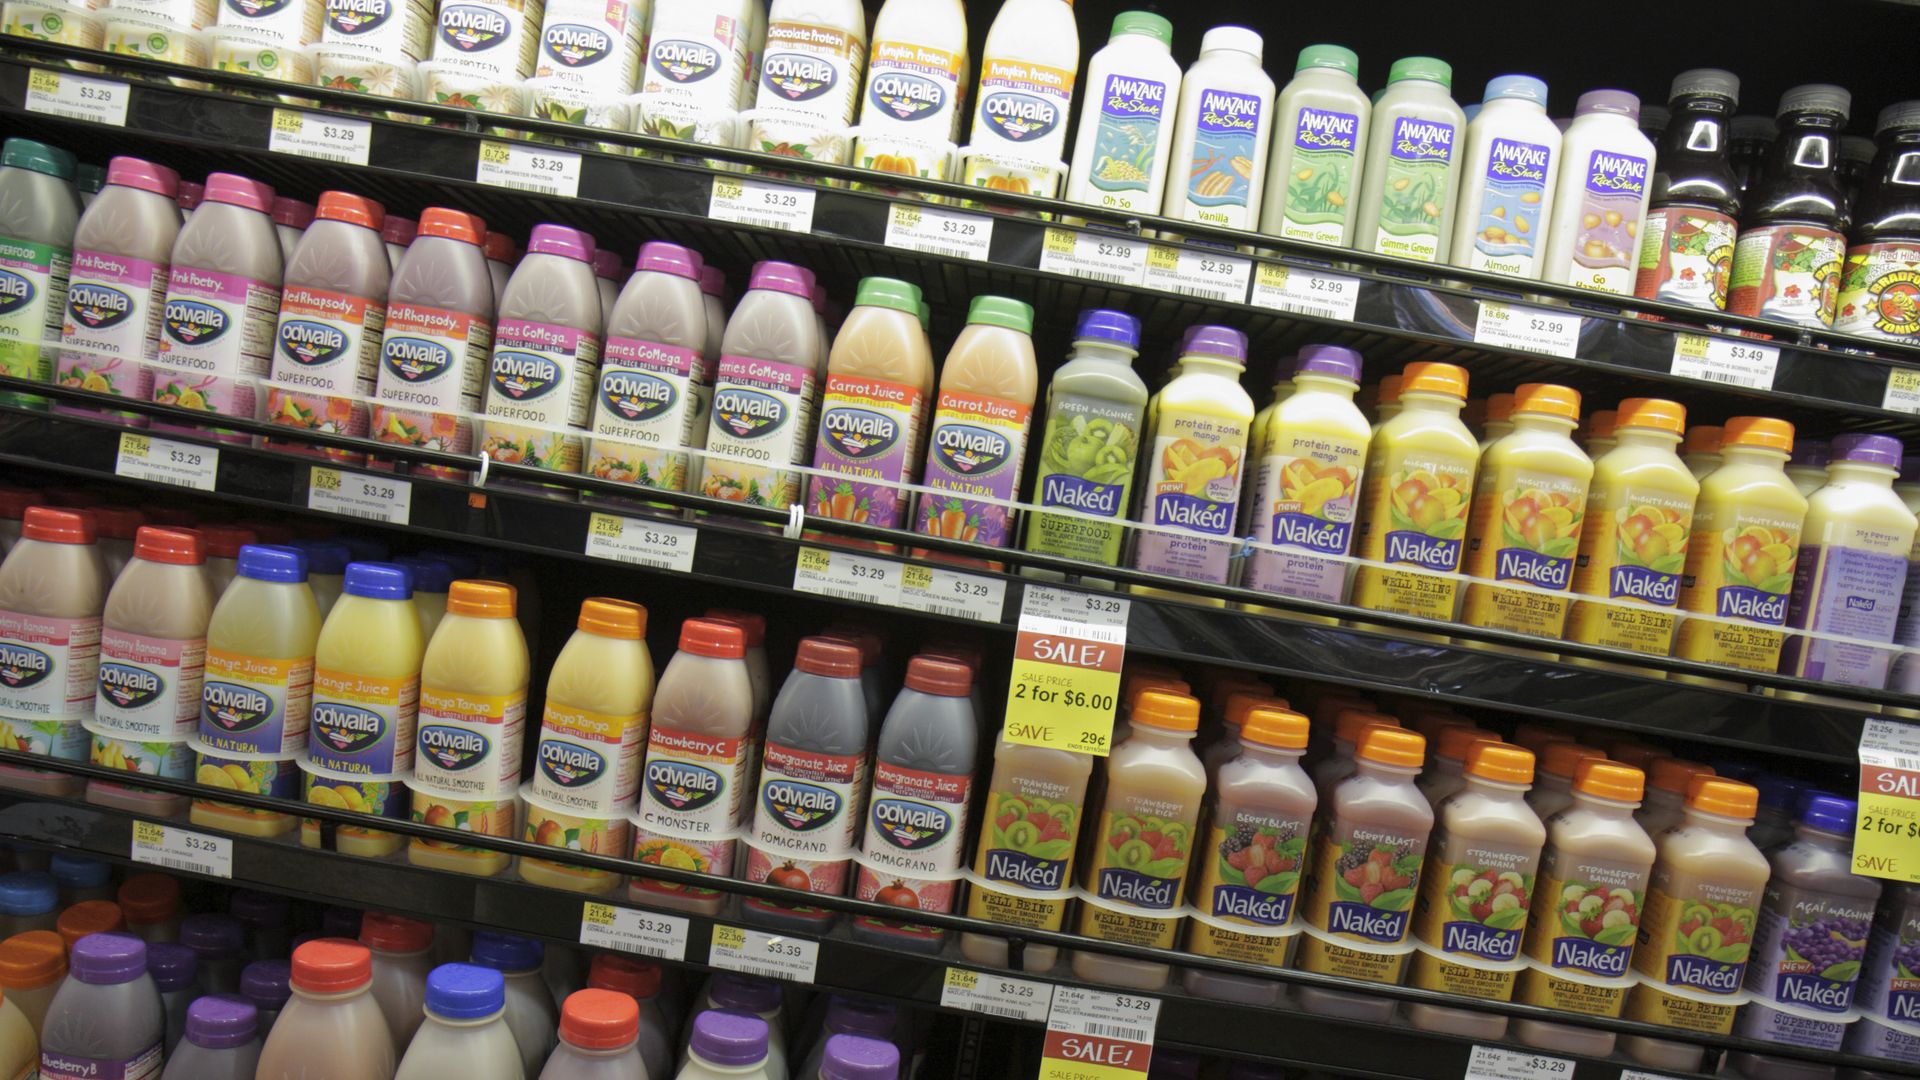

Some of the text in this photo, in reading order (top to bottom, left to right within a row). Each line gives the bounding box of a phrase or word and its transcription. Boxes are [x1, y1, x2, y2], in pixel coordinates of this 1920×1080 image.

[811, 29, 844, 47] Protein
[879, 43, 948, 66] Pumpkin Protein
[990, 62, 1062, 85] Pumpkin Protein
[80, 86, 112, 101] $3.29
[1109, 76, 1163, 101] AMAZAKE
[1108, 96, 1160, 116] Rice Shake
[1203, 91, 1257, 116] AMAZAKE
[1202, 111, 1255, 130] Rice Shake
[1301, 110, 1354, 135] AMAZAKE
[323, 126, 354, 141] $3.29
[1299, 130, 1351, 149] Rice Shake
[1398, 120, 1451, 145] AMAZAKE
[1493, 141, 1546, 167] AMAZAKE
[531, 157, 563, 173] $3.29
[1492, 162, 1543, 181] Rice Shake
[1593, 153, 1645, 179] AMAZAKE
[764, 192, 797, 208] $3.29
[1103, 195, 1131, 208] Oh So
[1198, 210, 1229, 223] Vanilla
[943, 220, 976, 236] $3.29
[1285, 226, 1339, 243] Gimme Green
[1098, 243, 1131, 258] $2.99
[76, 253, 126, 275] Pink Poetry
[1200, 260, 1233, 275] $2.99
[1483, 259, 1520, 274] Almond
[172, 271, 222, 292] Pink Poetry
[1310, 278, 1343, 294] $2.99
[1592, 274, 1606, 284] Go
[300, 291, 352, 313] Rhapsody
[403, 308, 455, 330] Rhapsody
[1530, 319, 1563, 334] $2.99
[1875, 318, 1920, 335] TONIC
[1731, 346, 1763, 361] $3.49
[161, 355, 215, 371] SUPERFOOD
[829, 378, 905, 401] Carrot Juice
[941, 395, 1018, 419] Carrot Juice
[1058, 401, 1089, 413] GREEN
[599, 424, 660, 443] SUPERFOOD
[1174, 418, 1213, 434] protein
[1192, 430, 1221, 442] mango
[1292, 437, 1331, 452] protein
[170, 450, 201, 466] $3.29
[1311, 449, 1339, 463] mango
[363, 484, 395, 500] $3.29
[931, 479, 995, 498] ALL NATURAL
[1046, 480, 1114, 512] Naked
[1159, 483, 1185, 494] new!
[1159, 498, 1227, 530] Naked
[644, 531, 677, 547] $3.29
[1169, 538, 1208, 553] protein
[1389, 536, 1456, 566] Naked
[851, 564, 885, 580] $3.29
[1500, 553, 1566, 585] Naked
[954, 581, 988, 597] $3.29
[1086, 598, 1120, 613] $3.29
[1492, 592, 1561, 613] WELL BEING
[1722, 591, 1785, 621] Naked
[135, 640, 167, 656] Banana
[1033, 639, 1105, 667] SALE!
[355, 678, 390, 695] Juice
[1022, 673, 1072, 688] SALE PRICE
[423, 692, 491, 713] Mango Tango
[1015, 684, 1113, 711] 2 for $6.00
[125, 720, 160, 735] SMOOTHIE
[1008, 722, 1056, 742] SAVE
[216, 737, 259, 754] NATURAL
[651, 729, 726, 755] Strawberry C
[825, 757, 848, 774] Juice
[1012, 777, 1071, 794] STRAWBERRY
[1020, 786, 1065, 799] KIWI KICK
[1868, 805, 1916, 820] SALE PRICE
[1236, 813, 1301, 831] BERRY BLAST
[1862, 816, 1902, 835] 2 for
[185, 837, 217, 852] $3.29
[1466, 849, 1530, 864] STRAWBERRY
[1478, 858, 1516, 870] BANANA
[1856, 854, 1898, 873] SAVE
[989, 855, 1058, 886] Naked
[1217, 890, 1286, 921] Naked
[1795, 901, 1875, 922] AÇAÍ MACHINE
[638, 919, 672, 935] $3.29
[768, 942, 801, 957] $3.39
[1449, 926, 1516, 956] Naked
[1557, 942, 1626, 972] Naked
[1671, 959, 1738, 989] Naked
[1782, 962, 1811, 973] NEW!
[1000, 983, 1034, 998] $3.29
[1782, 977, 1849, 1007] Naked
[1116, 996, 1151, 1011] $3.29
[1062, 1039, 1133, 1066] SALE!
[41, 1052, 98, 1076] Blueberry B
[1531, 1058, 1566, 1073] $3.29
